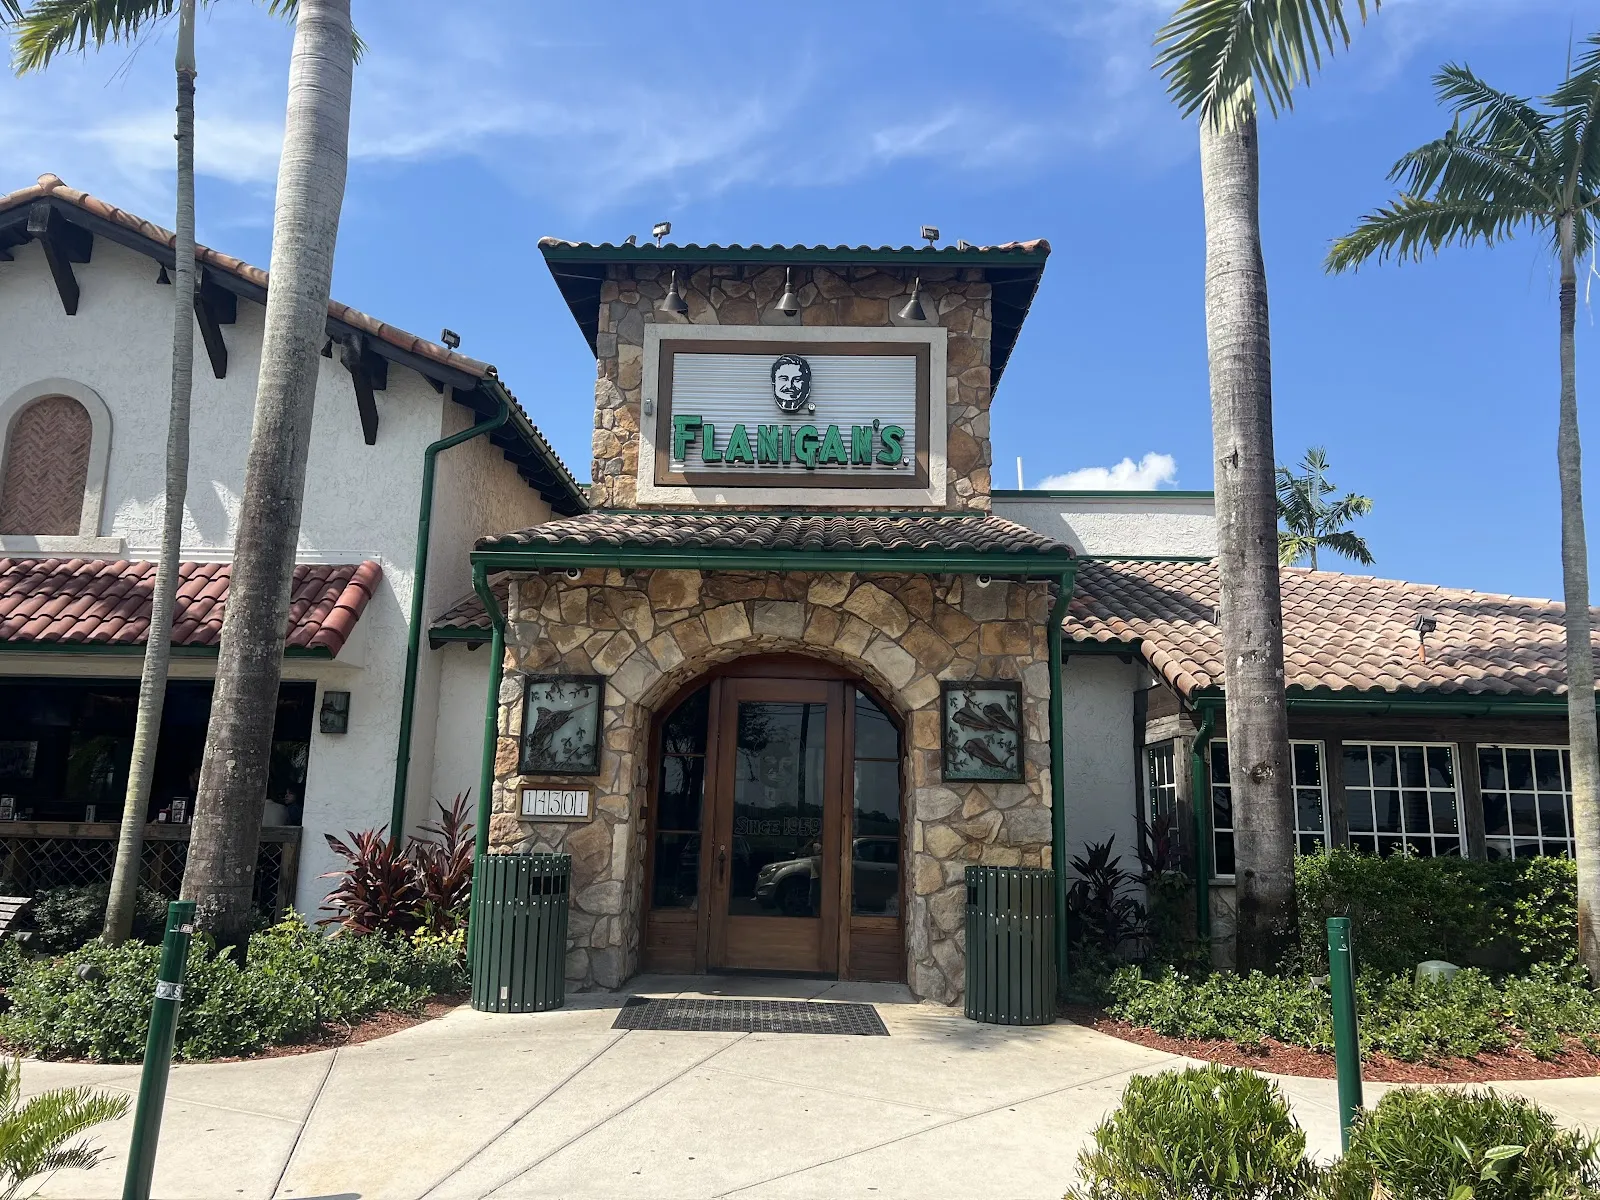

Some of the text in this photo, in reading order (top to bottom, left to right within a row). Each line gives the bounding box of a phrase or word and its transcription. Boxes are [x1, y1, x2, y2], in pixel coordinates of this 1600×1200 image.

[673, 414, 906, 470] FLANIGAN'S
[525, 791, 584, 814] 14301
[783, 816, 821, 837] 1959
